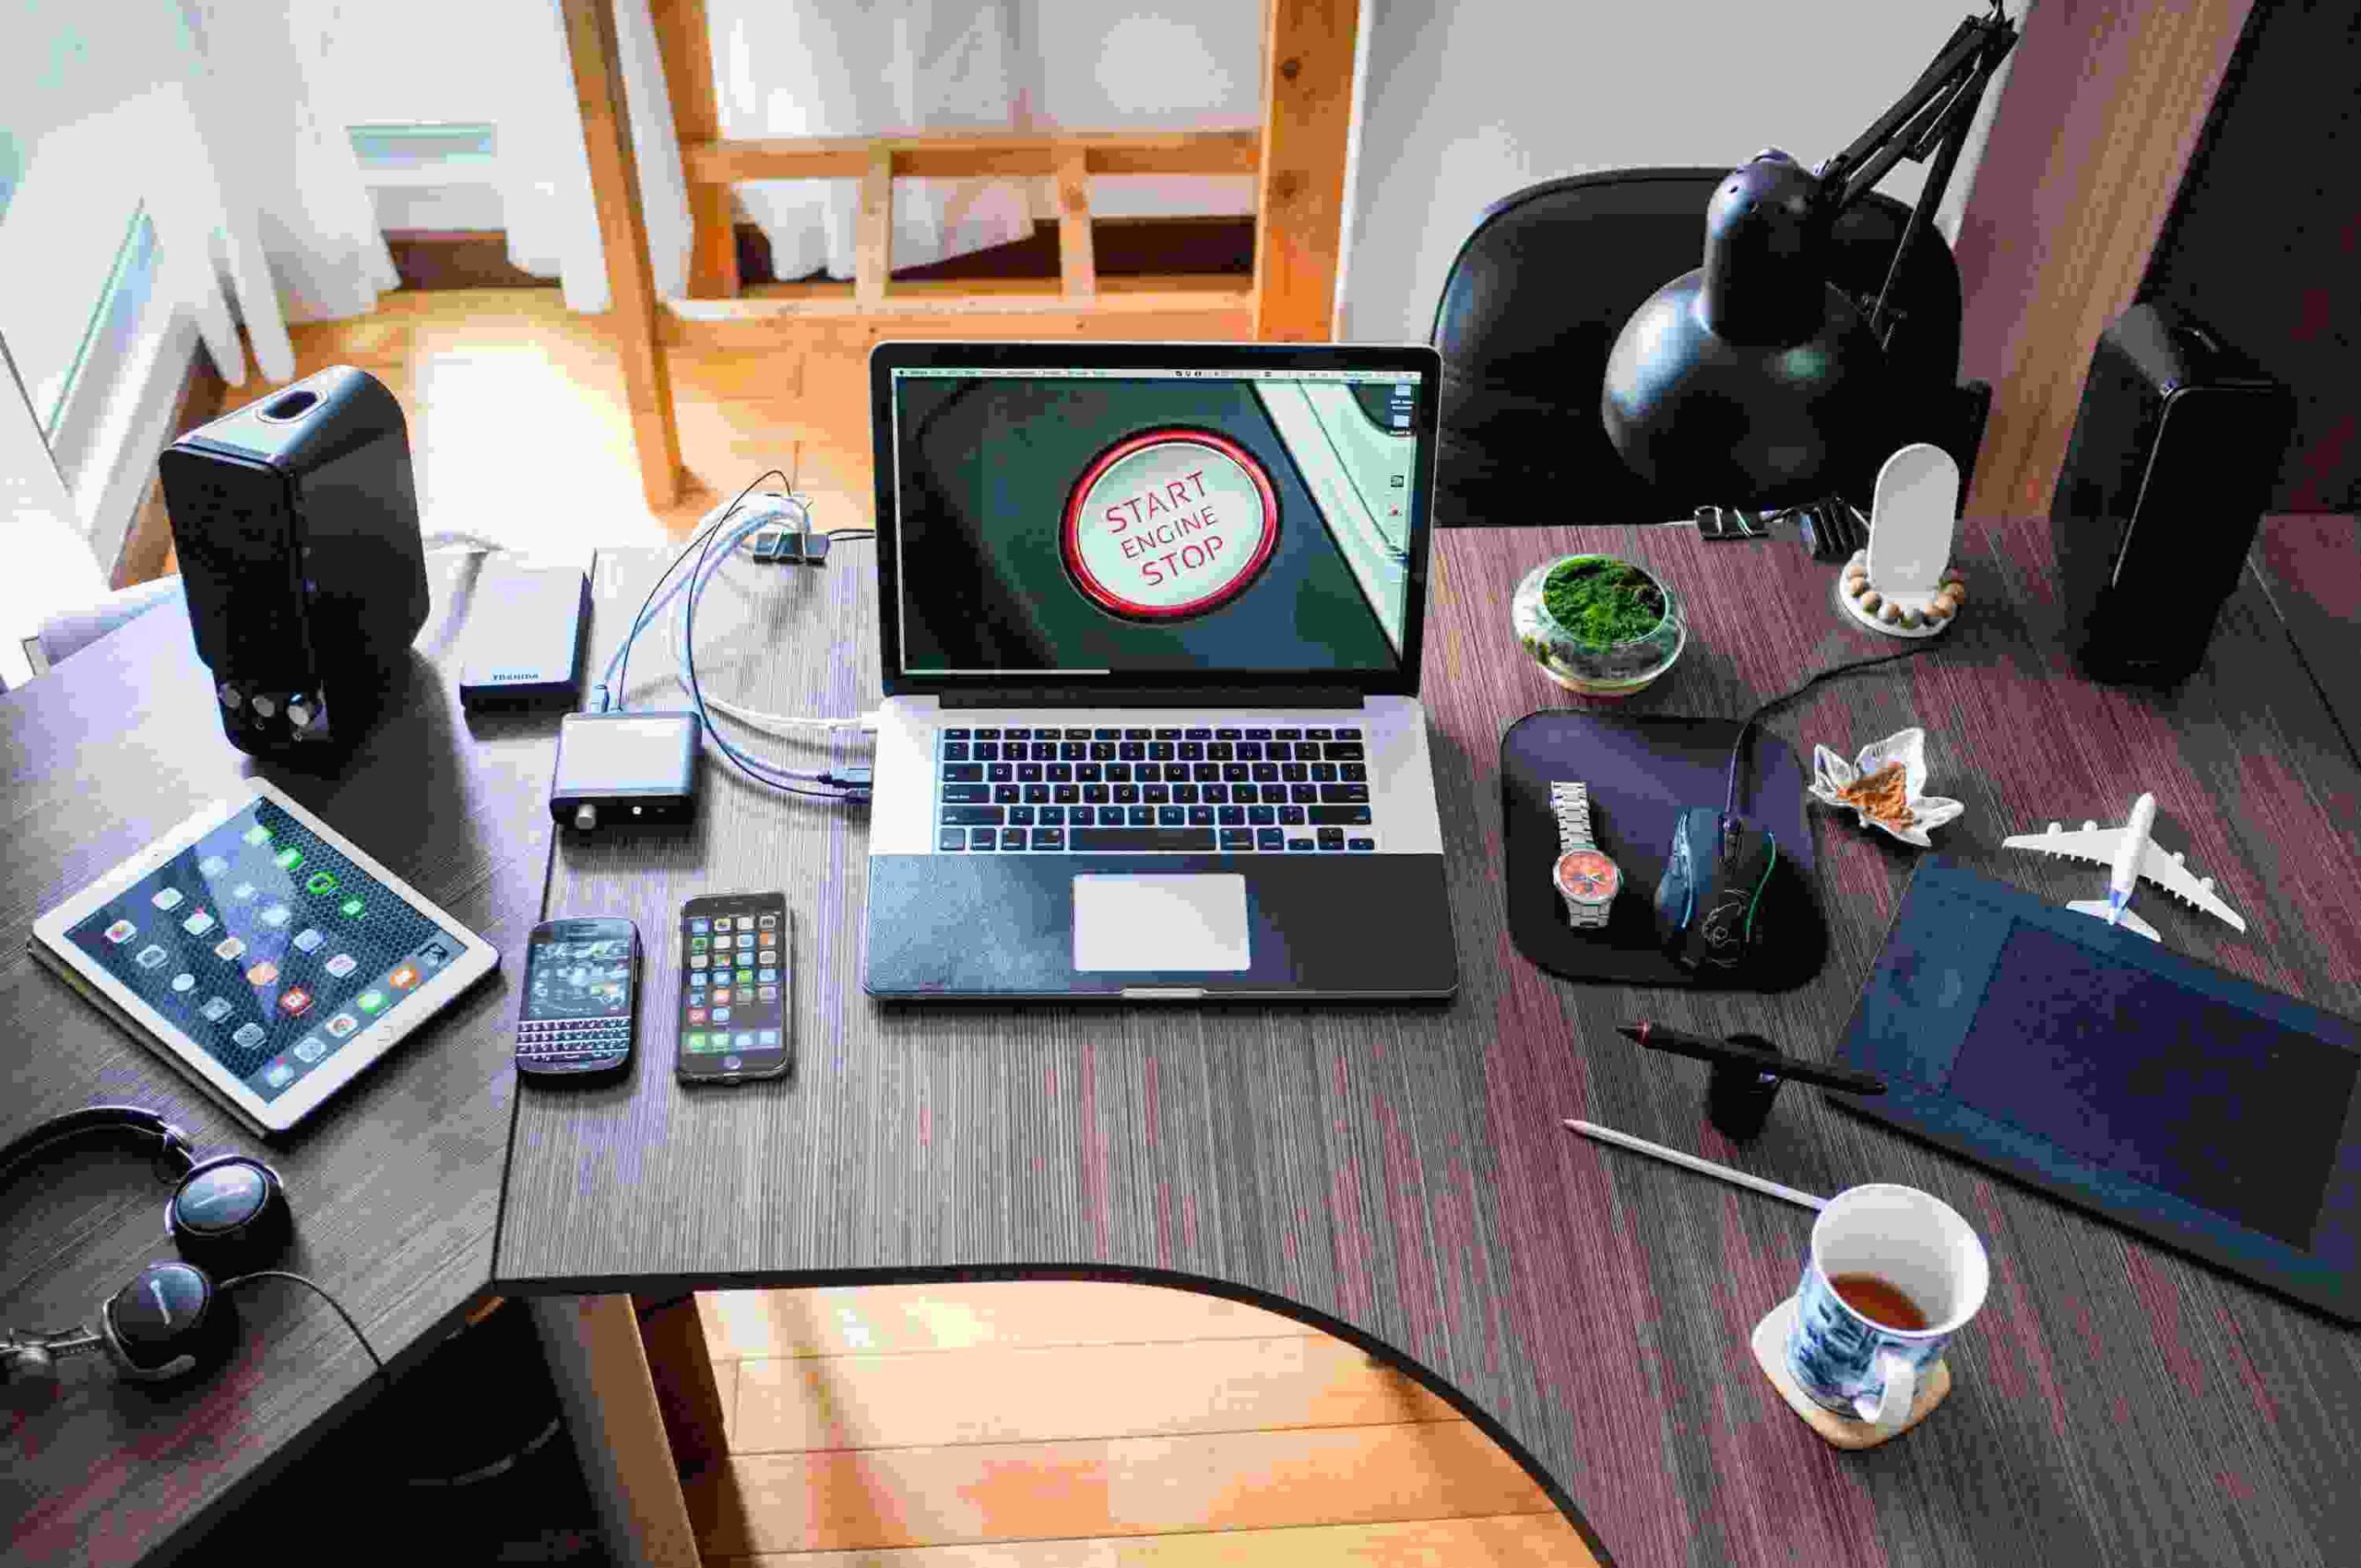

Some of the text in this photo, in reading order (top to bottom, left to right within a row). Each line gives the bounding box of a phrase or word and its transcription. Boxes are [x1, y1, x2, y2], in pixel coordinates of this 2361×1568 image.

[1106, 470, 1206, 533] START
[1121, 505, 1217, 559] ENGINE
[1142, 535, 1224, 586] STOP
